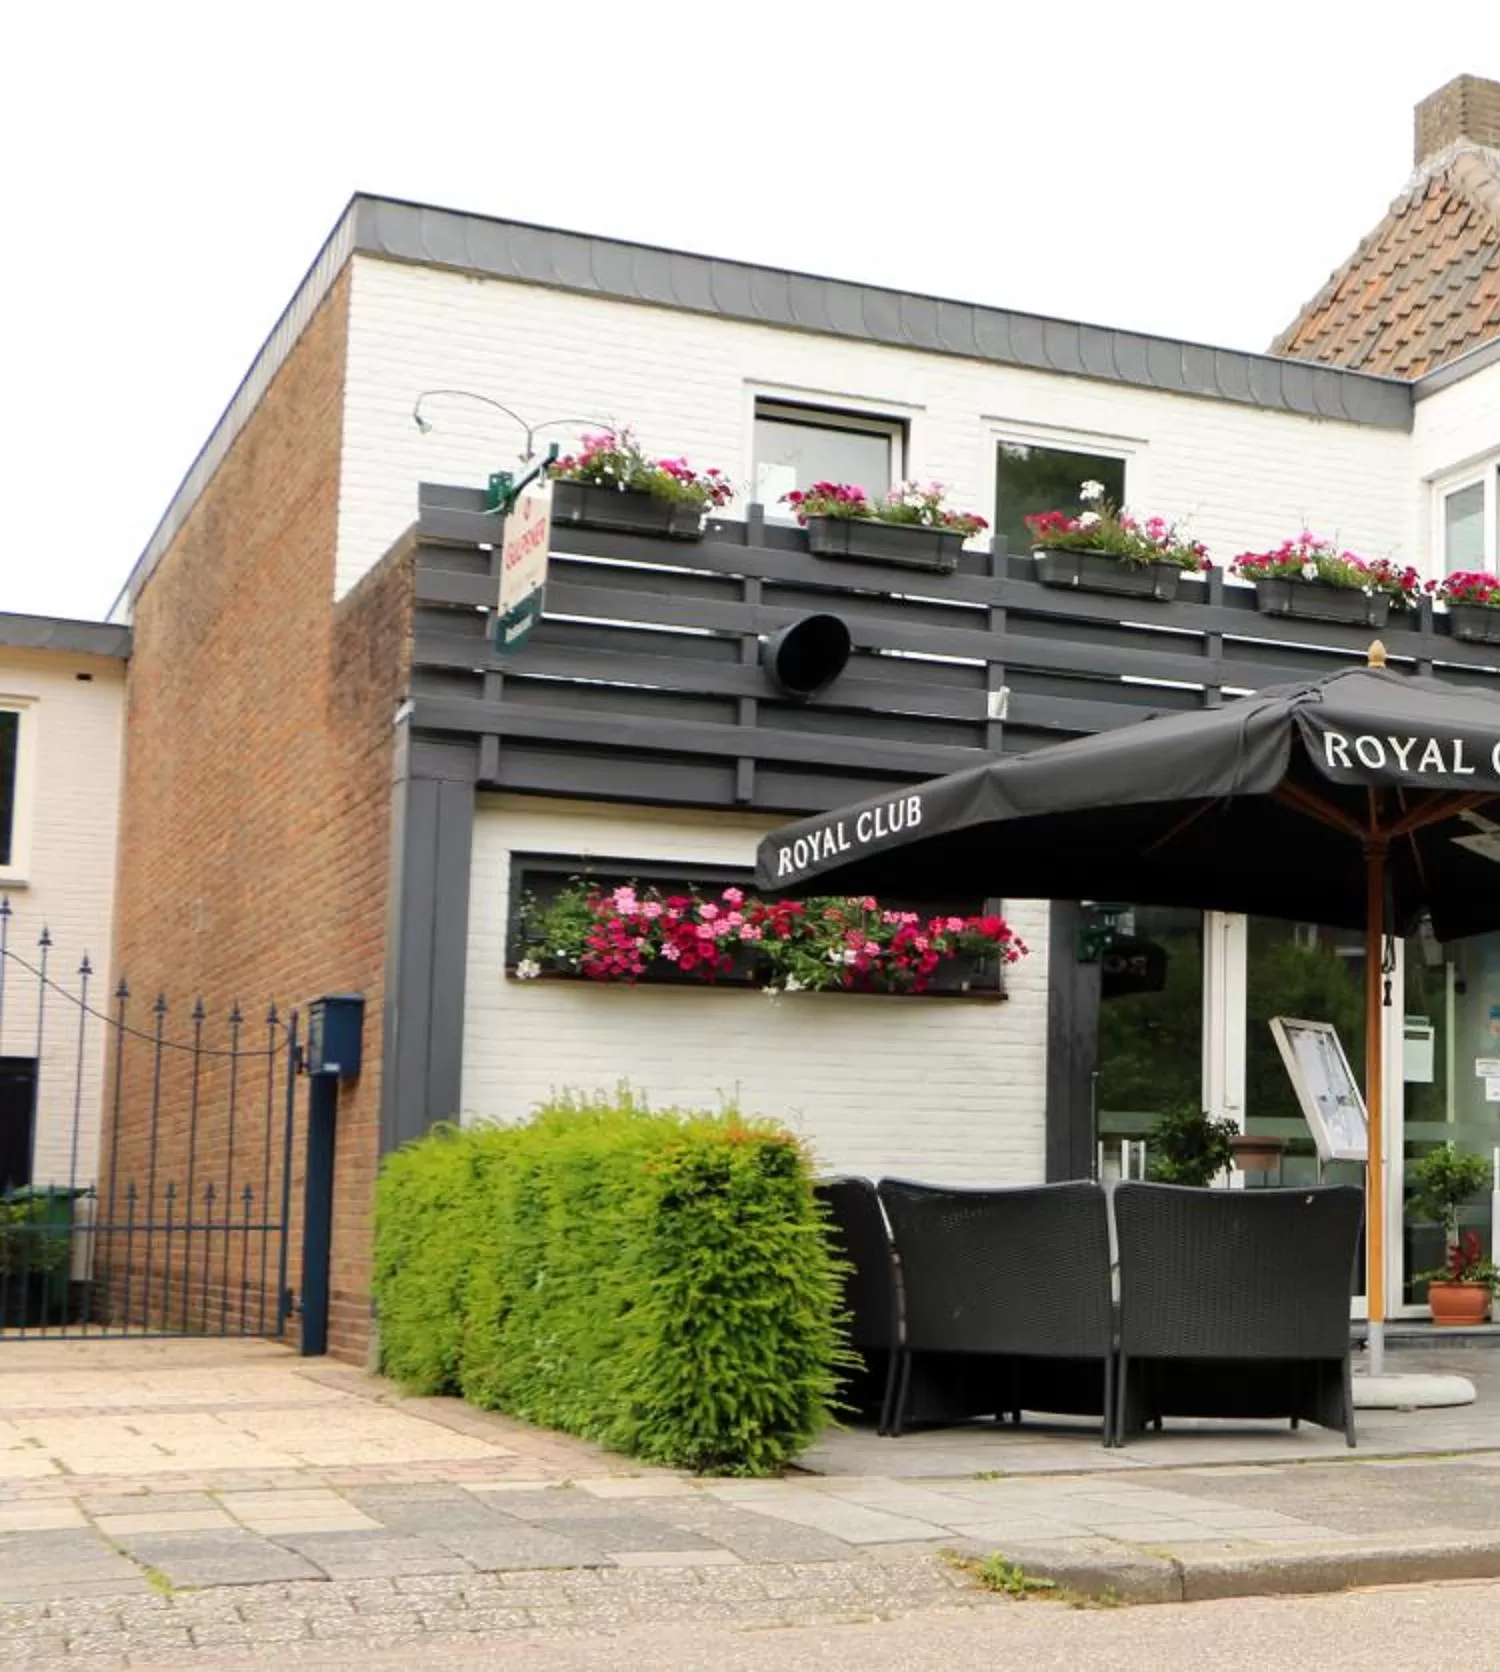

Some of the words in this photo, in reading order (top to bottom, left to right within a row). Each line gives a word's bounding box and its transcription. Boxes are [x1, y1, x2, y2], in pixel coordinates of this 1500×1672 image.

[1323, 731, 1475, 774] ROYAL
[777, 821, 851, 877] ROYAL
[856, 795, 922, 842] CLUB
